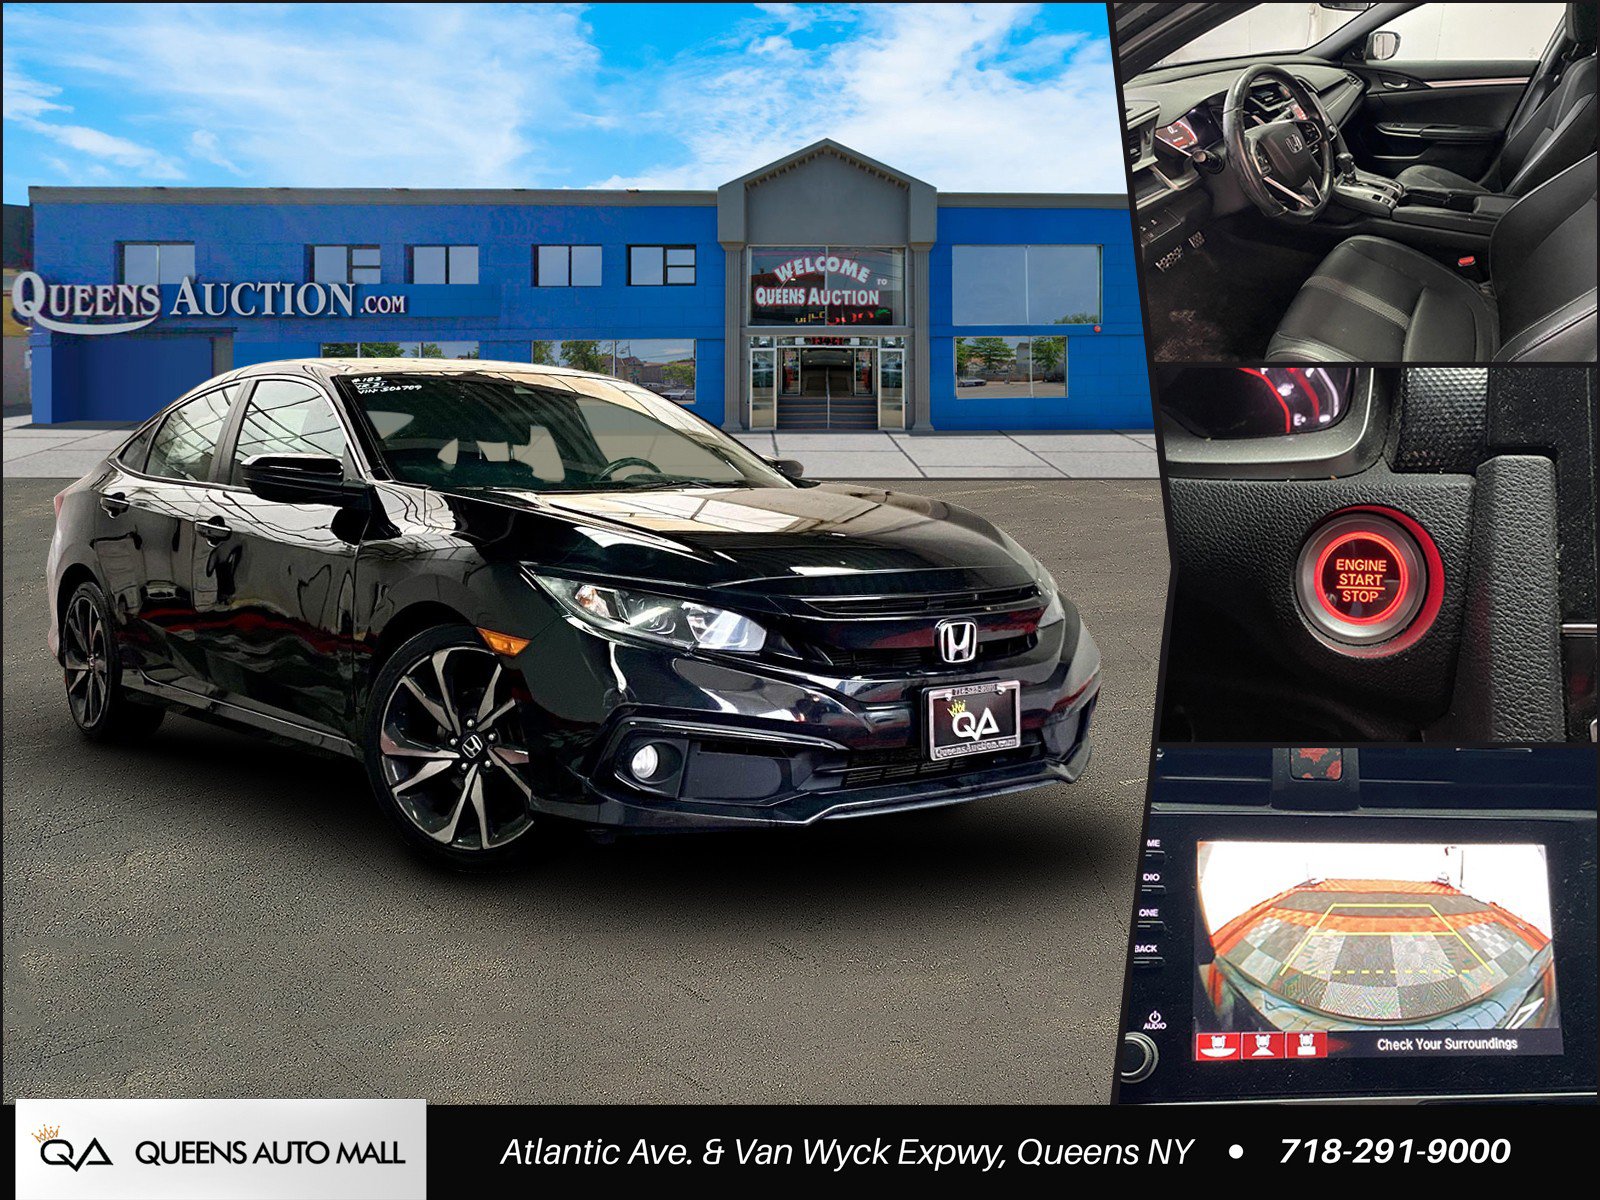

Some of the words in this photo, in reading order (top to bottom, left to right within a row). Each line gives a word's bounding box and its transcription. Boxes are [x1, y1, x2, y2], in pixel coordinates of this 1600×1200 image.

[774, 256, 871, 284] WELCOME
[12, 271, 161, 335] QUEENS
[755, 286, 806, 306] QUEENS
[808, 287, 879, 306] AUCTION
[1336, 558, 1387, 572] ENGINE
[1339, 573, 1383, 586] START
[1342, 590, 1379, 603] STOP
[1143, 1022, 1167, 1030] AUDIO
[1377, 1038, 1413, 1051] Check
[1415, 1038, 1442, 1050] Your
[1444, 1037, 1518, 1051] Surroundings
